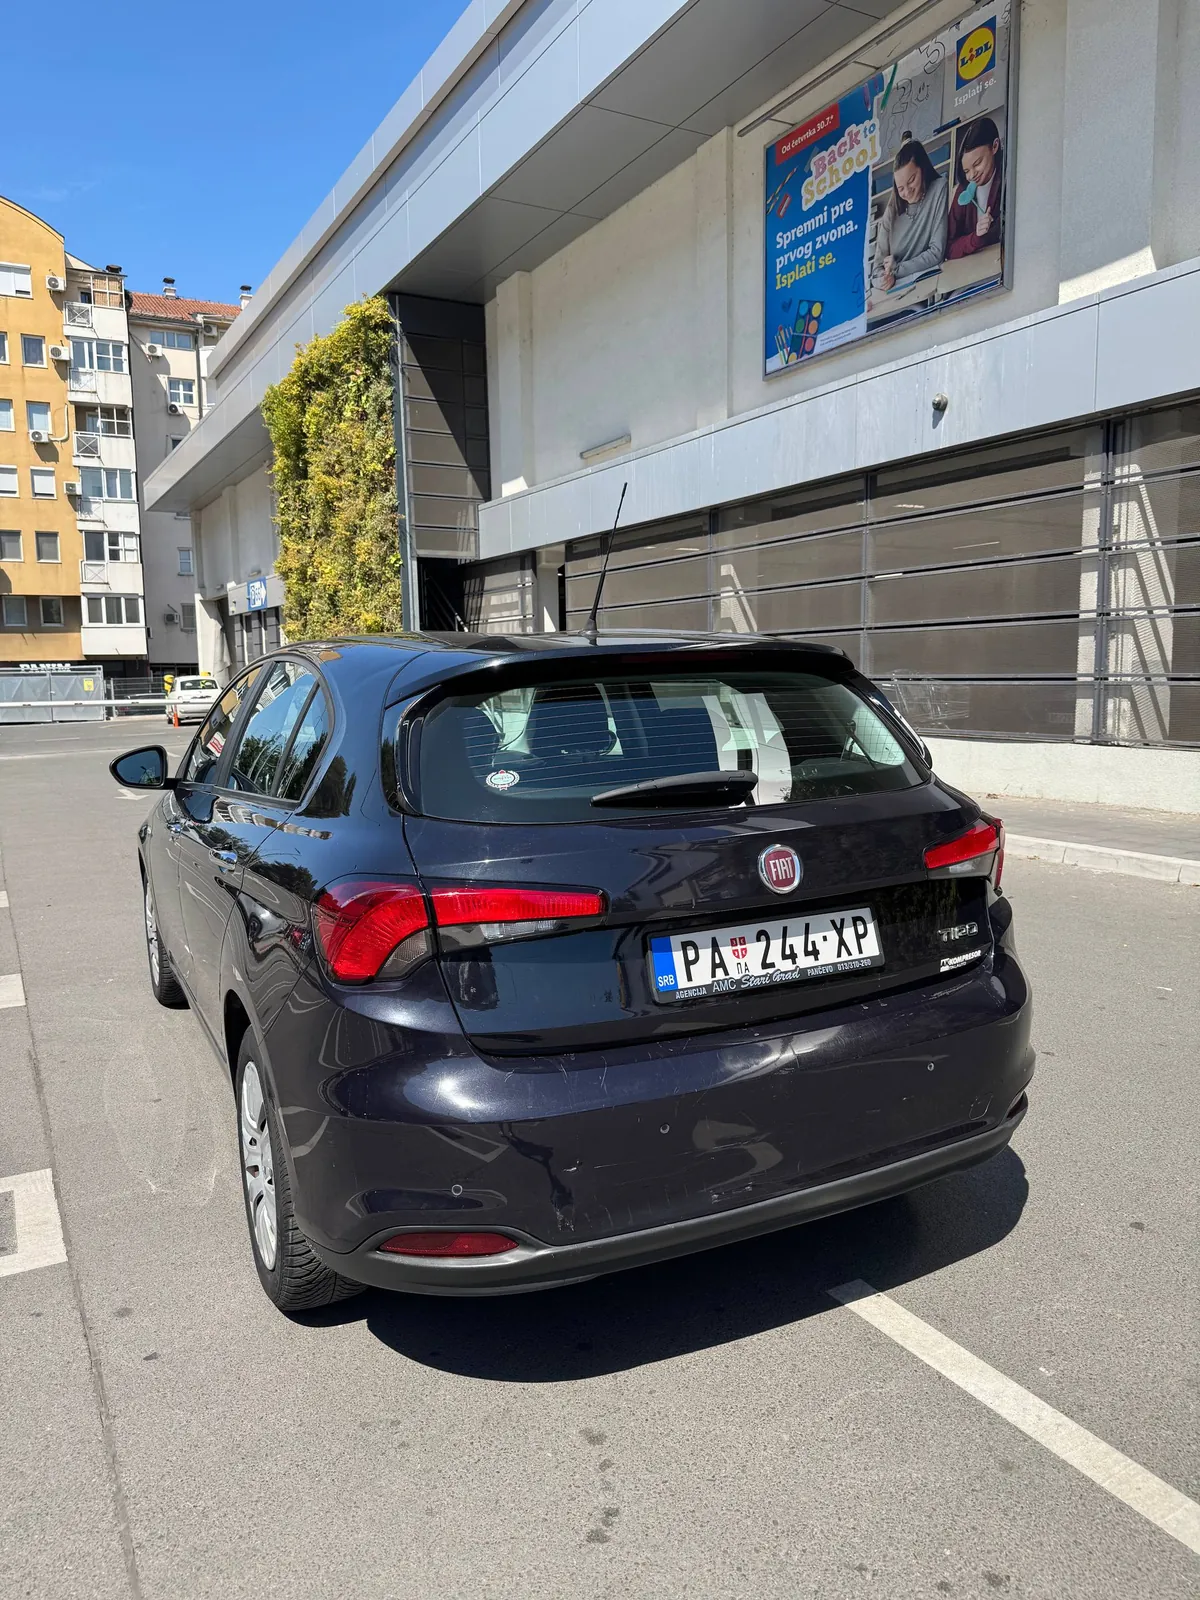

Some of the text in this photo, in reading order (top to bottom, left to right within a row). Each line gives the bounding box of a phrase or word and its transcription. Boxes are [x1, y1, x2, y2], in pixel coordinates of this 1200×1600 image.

[954, 78, 997, 107] Isplati se.
[781, 142, 791, 154] Od
[791, 128, 816, 148] četvrtka
[814, 122, 876, 180] Back to
[803, 134, 878, 206] School
[776, 198, 854, 249] Spremni pre
[775, 220, 858, 273] prvog zvona.
[775, 252, 836, 290] Isplati se.
[769, 857, 794, 881] FIAT
[680, 936, 730, 982] PA
[657, 974, 675, 987] SRB
[675, 986, 707, 999] AGENCIJA
[712, 978, 736, 993] AMC
[741, 973, 771, 988] Stari
[772, 966, 801, 982] Grad
[807, 965, 833, 976] PANČEVO
